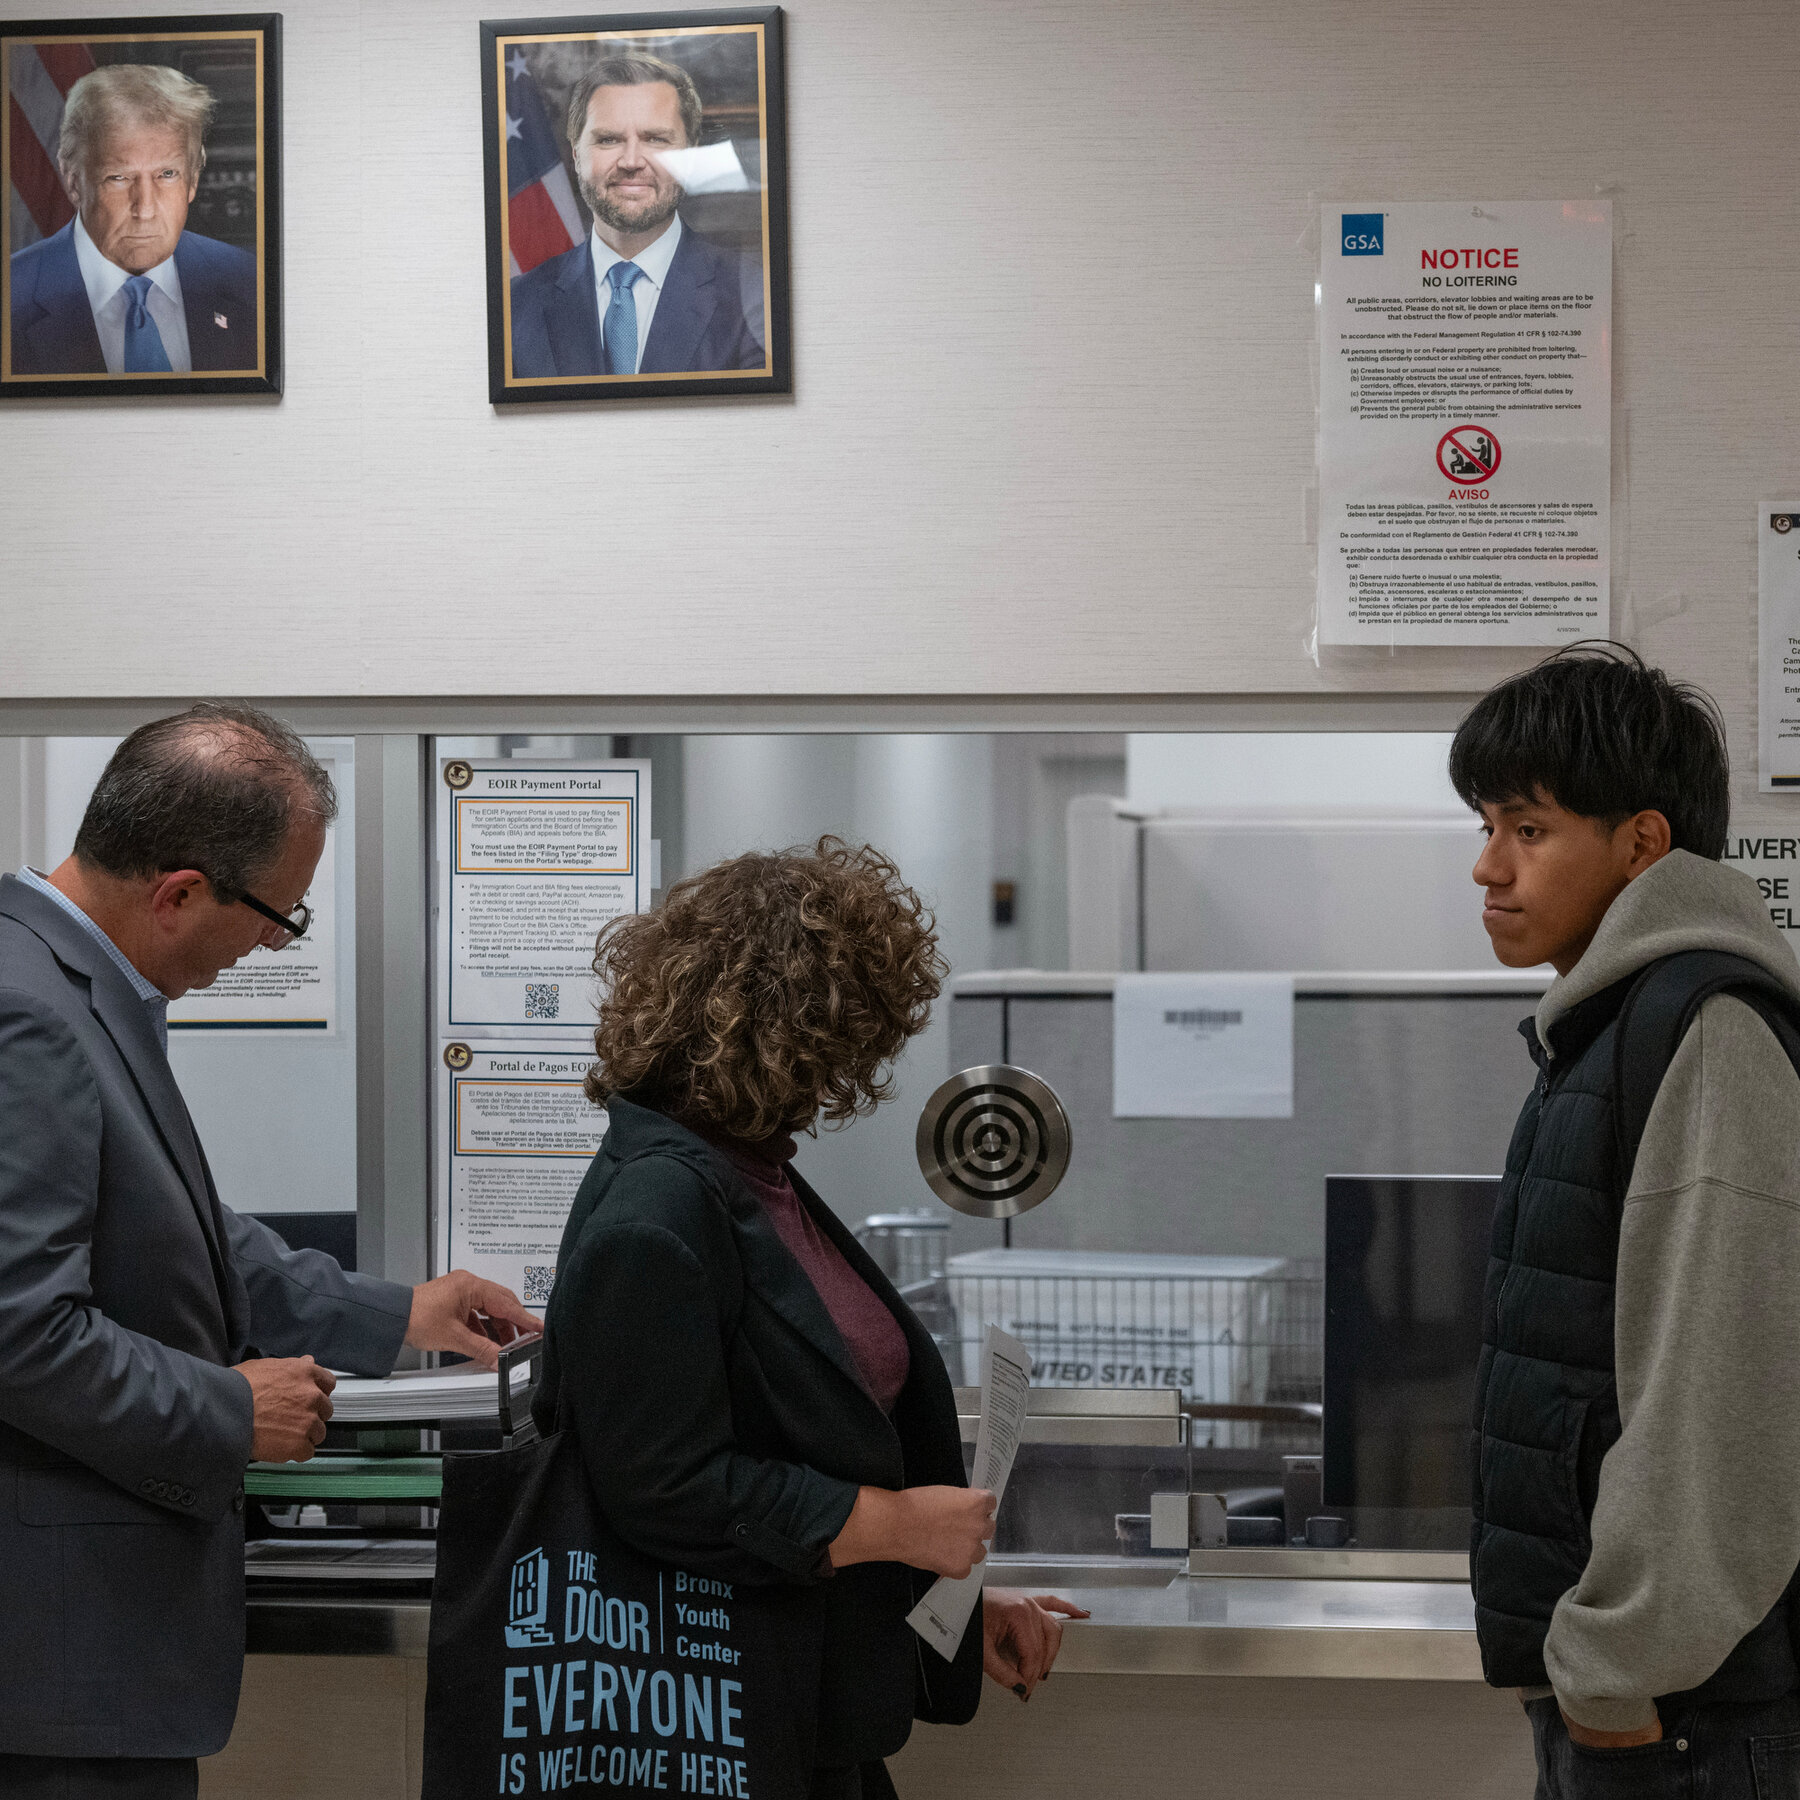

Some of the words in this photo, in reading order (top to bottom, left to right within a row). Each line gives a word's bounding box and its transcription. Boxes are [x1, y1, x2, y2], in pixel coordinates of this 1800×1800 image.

[1344, 234, 1381, 250] GSA
[1421, 248, 1519, 270] NOTICE
[1422, 276, 1442, 287] NO
[1446, 275, 1518, 287] LOITERING
[1357, 297, 1380, 305] public
[1404, 296, 1439, 304] corridors,
[1513, 295, 1540, 303] waiting
[1455, 304, 1467, 312] sit,
[1508, 303, 1528, 312] place
[1473, 312, 1498, 321] people
[1438, 331, 1480, 339] Management
[1481, 331, 1516, 339] Regulation
[1448, 489, 1490, 500] AVISO
[1412, 531, 1451, 539] Reglamento
[488, 779, 517, 790] EOIR
[521, 779, 566, 793] Payment
[569, 779, 601, 790] Portal
[581, 851, 617, 859] drop-down
[1719, 838, 1800, 859] LIVER
[490, 1060, 521, 1072] Portal
[523, 1061, 536, 1072] de
[539, 1061, 568, 1074] Pagos
[571, 1062, 596, 1073] EOI
[1100, 1364, 1194, 1386] STATES
[567, 1550, 598, 1583] THE
[675, 1571, 734, 1600] Bronx
[564, 1586, 650, 1654] DOOR
[675, 1603, 731, 1631] Youth
[676, 1636, 742, 1666] Center
[503, 1660, 745, 1748] EVERYONE
[499, 1753, 526, 1794] IS
[539, 1744, 669, 1791] WELCOME
[681, 1752, 750, 1799] HERE
